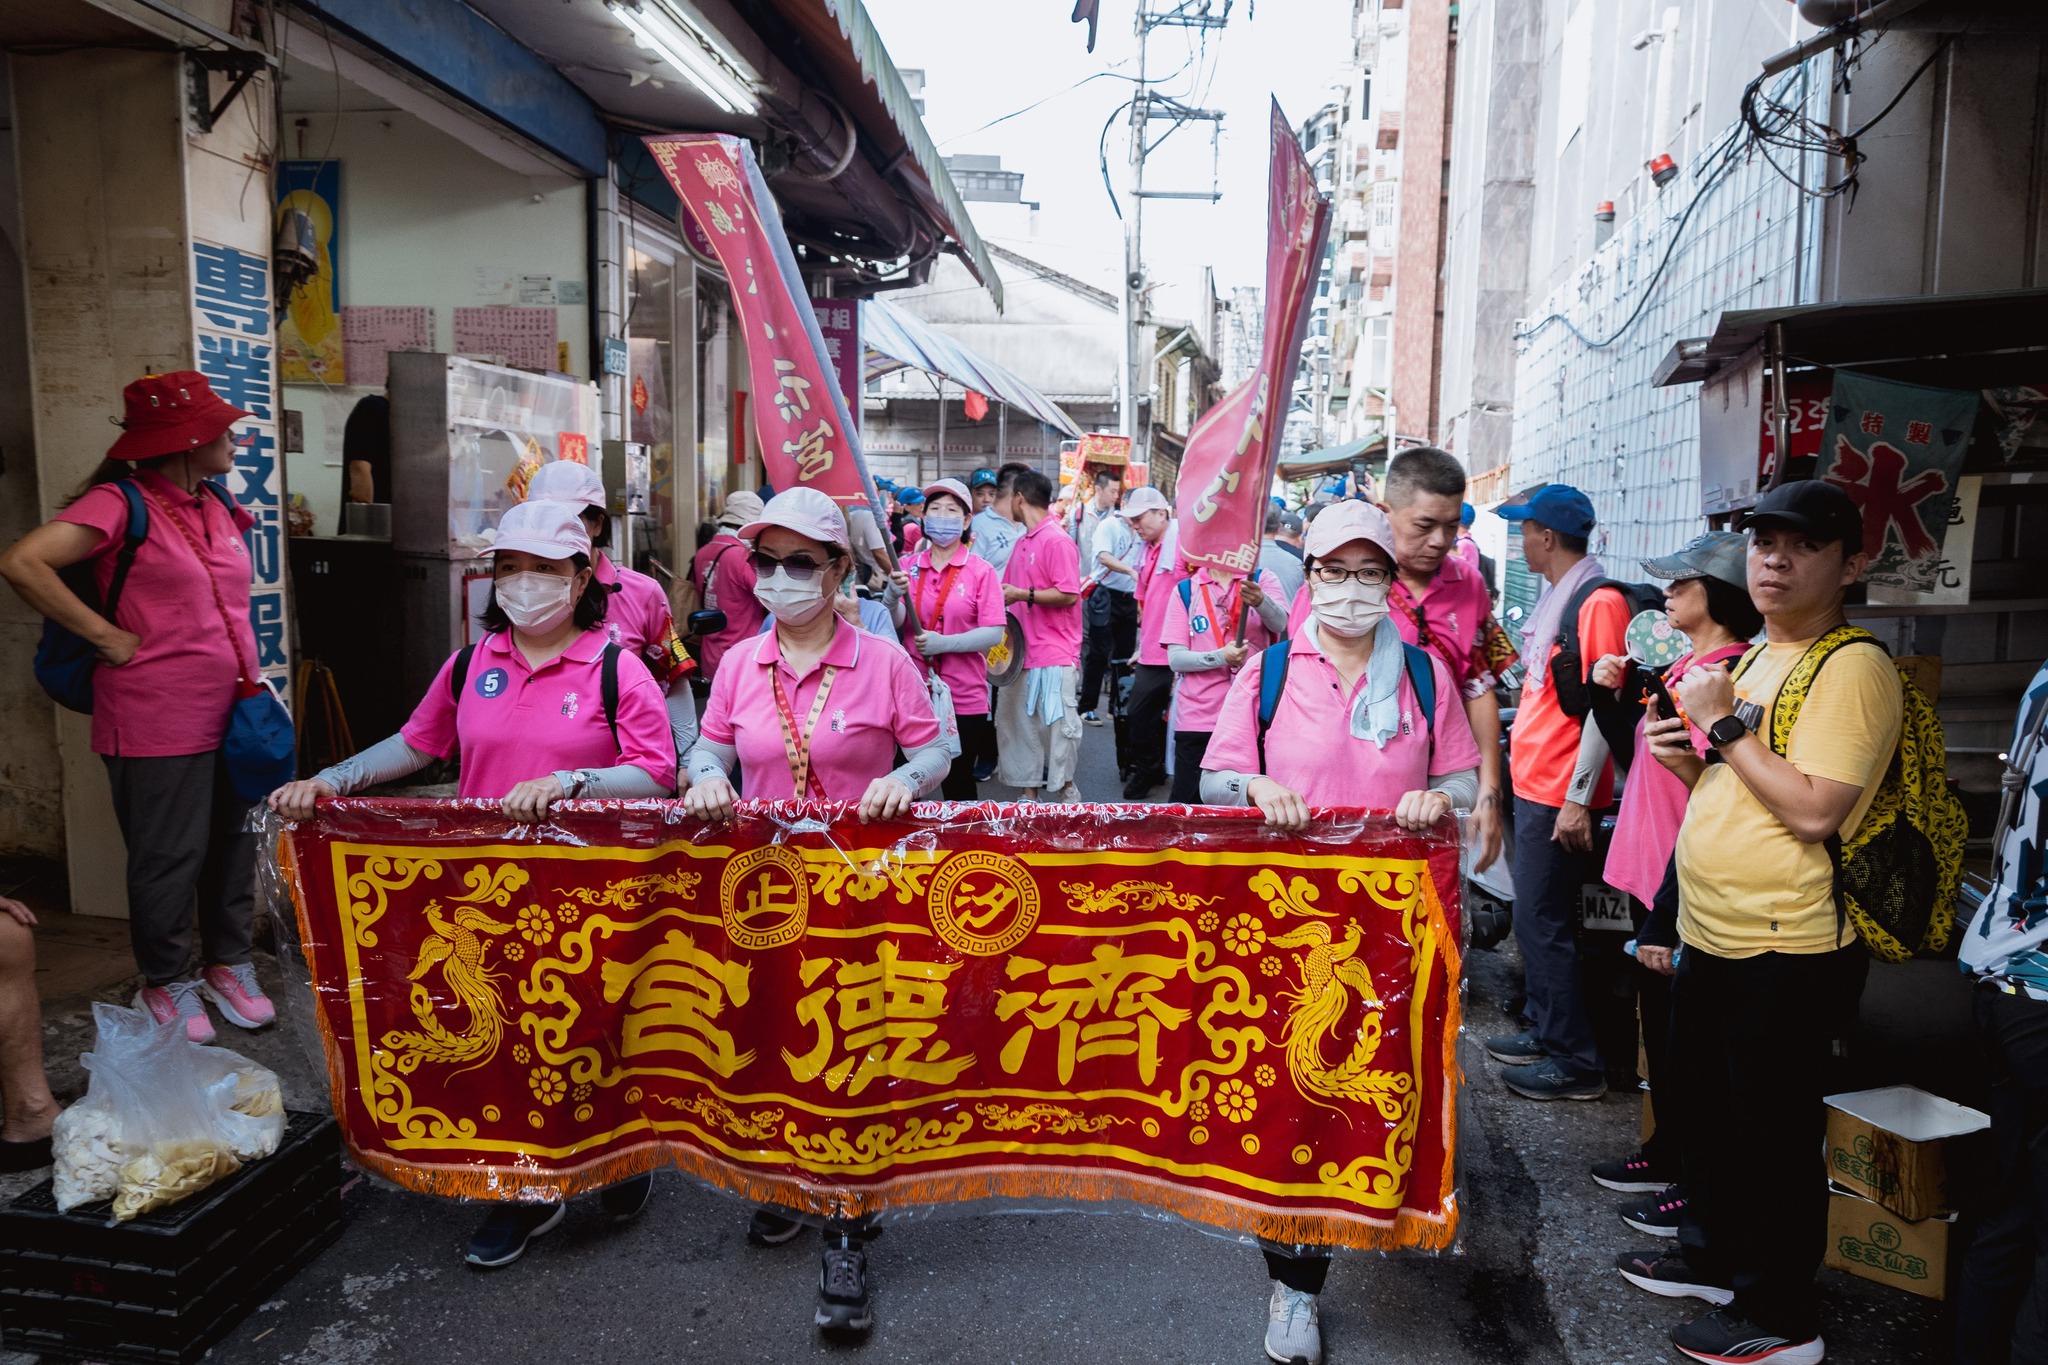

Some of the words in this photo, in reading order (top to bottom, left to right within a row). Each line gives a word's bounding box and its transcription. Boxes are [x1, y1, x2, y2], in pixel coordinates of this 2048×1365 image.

[1859, 410, 1933, 447] 特製
[193, 242, 288, 708] 專業技術服
[1193, 618, 1207, 630] 11
[484, 673, 499, 692] 5
[1843, 1240, 1927, 1277] 客家仙草
